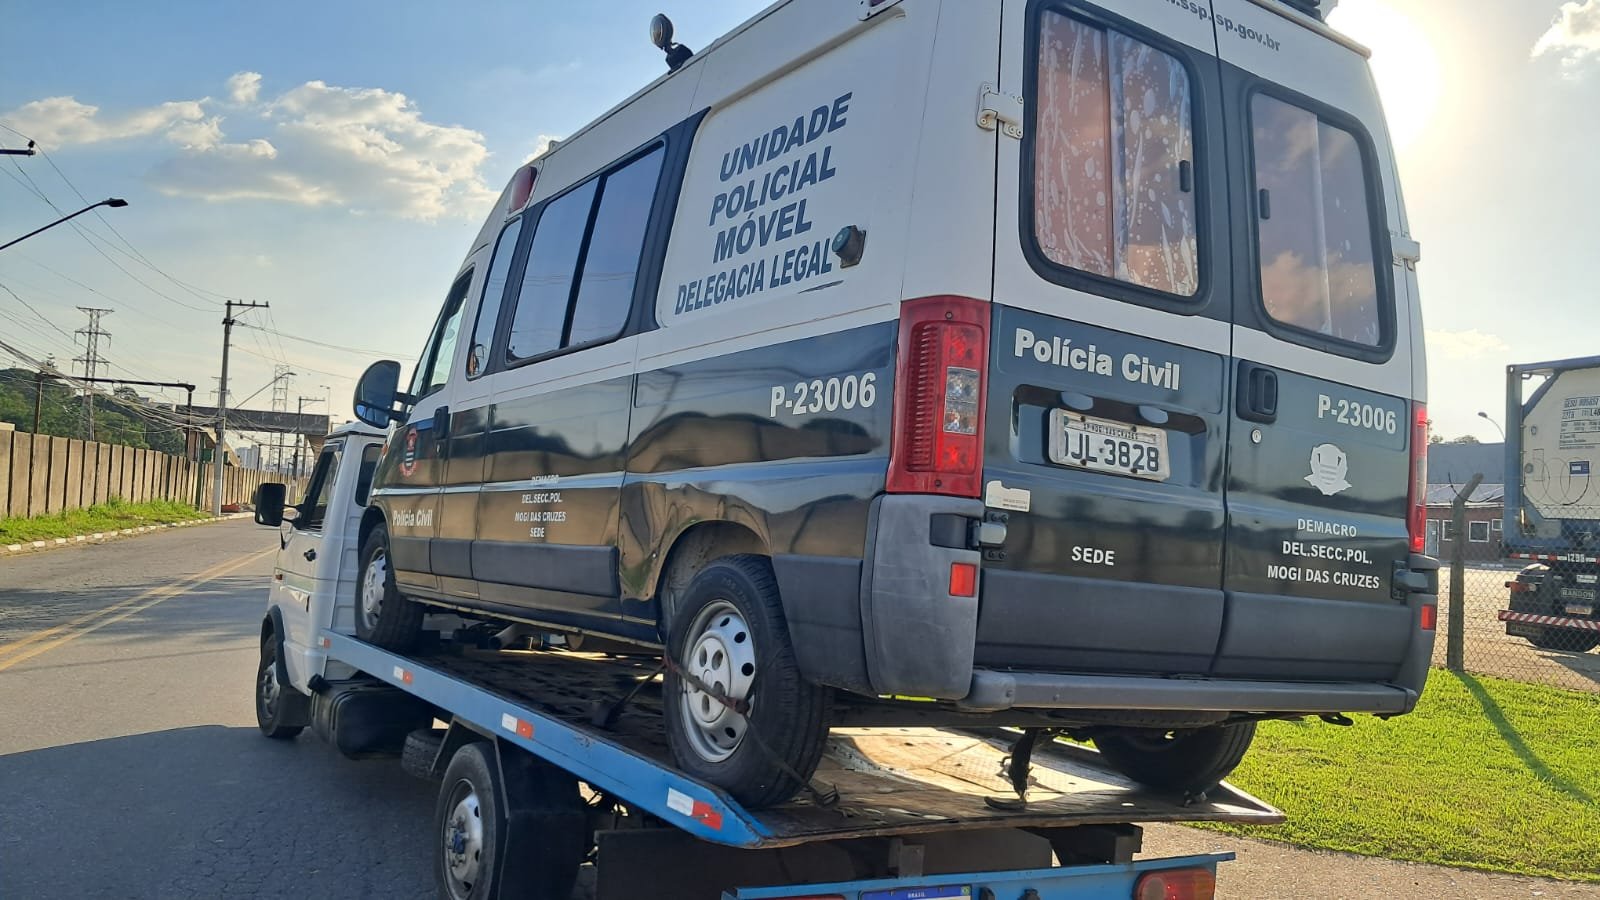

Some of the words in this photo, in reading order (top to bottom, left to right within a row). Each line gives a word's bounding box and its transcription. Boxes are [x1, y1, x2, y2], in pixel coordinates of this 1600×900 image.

[720, 91, 853, 183] UNIDADE
[709, 145, 836, 226] POLICIAL
[713, 198, 812, 264] MÓVEL
[674, 259, 764, 315] DELEGACIA
[769, 237, 833, 289] LEGAL
[1014, 328, 1113, 377] Polícia
[1121, 353, 1180, 391] Civil
[770, 372, 876, 417] P-23006
[1317, 394, 1397, 435] P-23006
[416, 508, 433, 527] Civil
[529, 527, 545, 538] SEDE
[530, 511, 542, 522] DAS
[542, 511, 567, 522] CRUZES
[1297, 518, 1357, 538] DEMACRO
[1071, 545, 1115, 566] SEDE
[1282, 540, 1373, 565] DEL.SECC.POL.
[1267, 564, 1301, 582] MOGI
[1305, 568, 1330, 584] DAS
[1333, 571, 1380, 590] CRUZES
